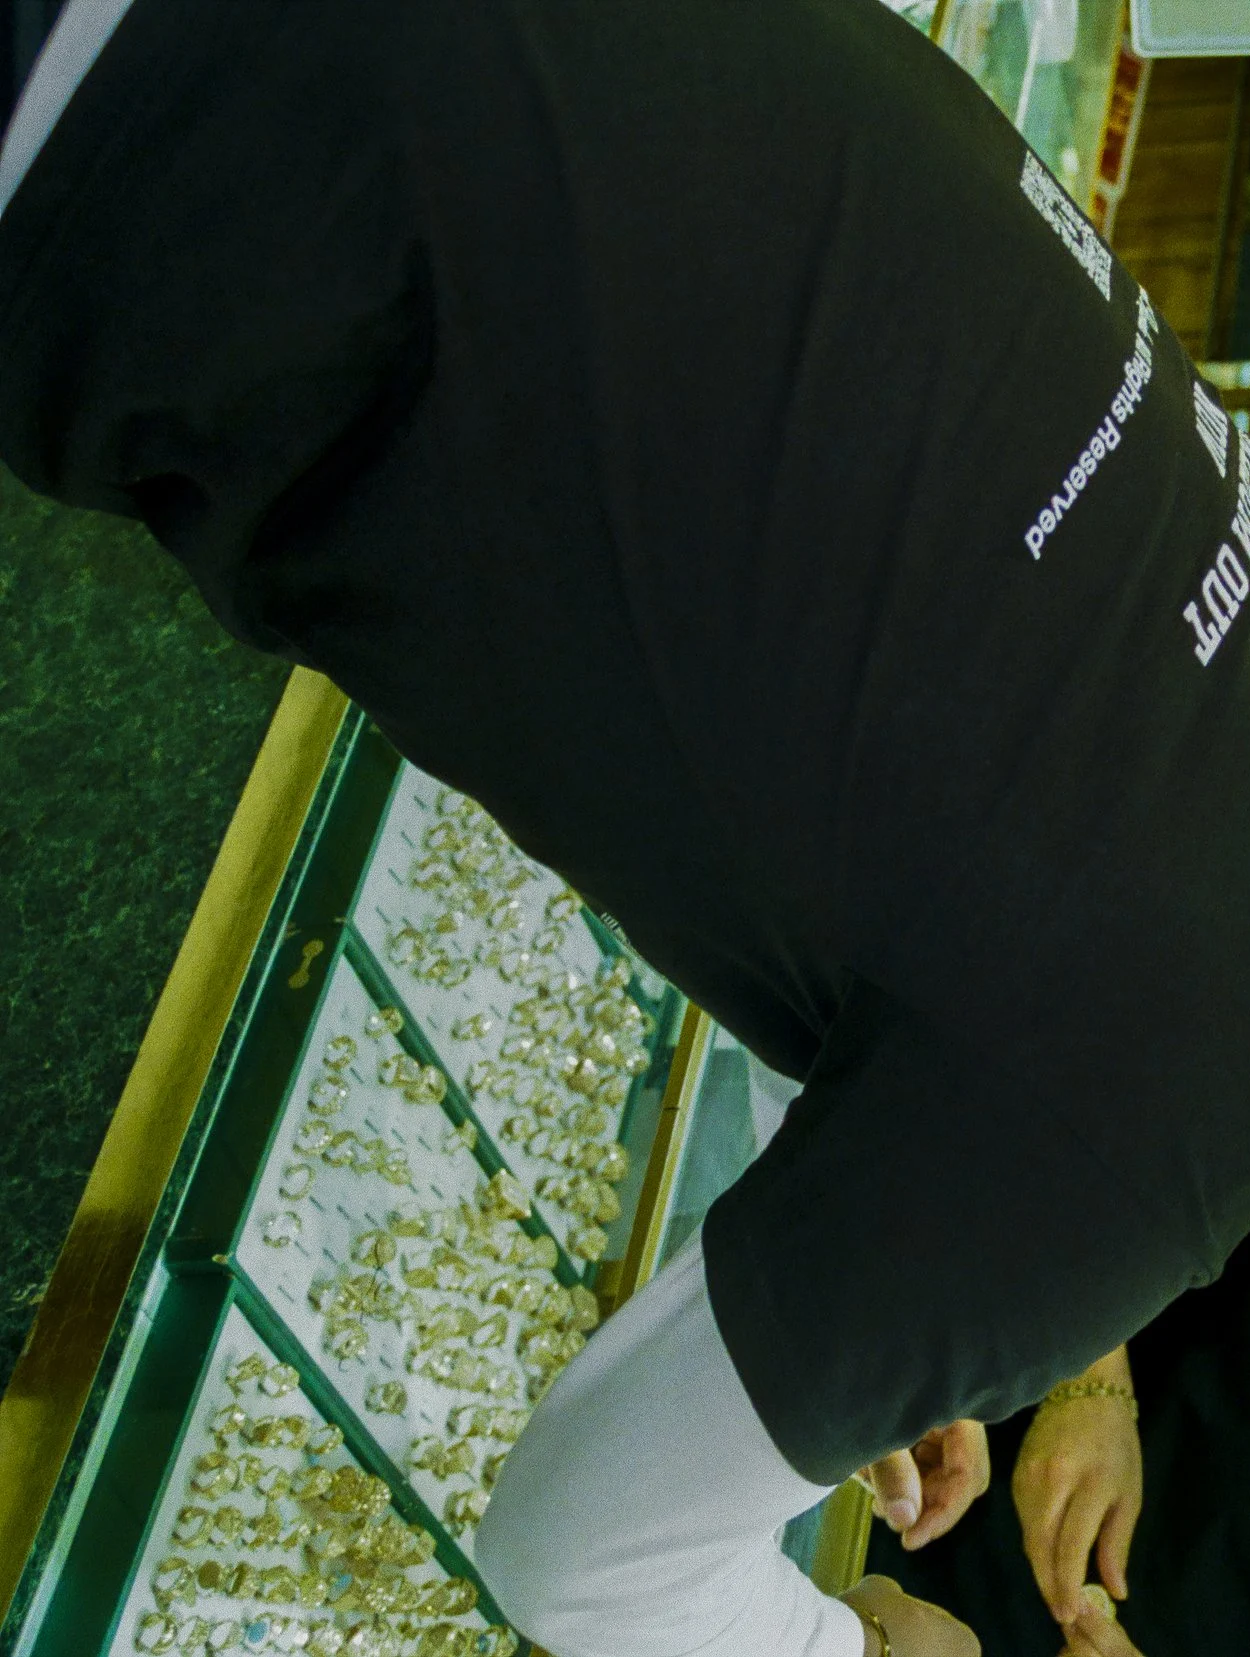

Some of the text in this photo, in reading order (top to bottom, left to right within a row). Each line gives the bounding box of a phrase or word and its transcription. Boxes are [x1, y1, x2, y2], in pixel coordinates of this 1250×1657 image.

[1110, 355, 1153, 423] Rights
[1192, 380, 1229, 477] NOW
[1024, 415, 1122, 561] Reserved
[1182, 542, 1250, 666] OUT
